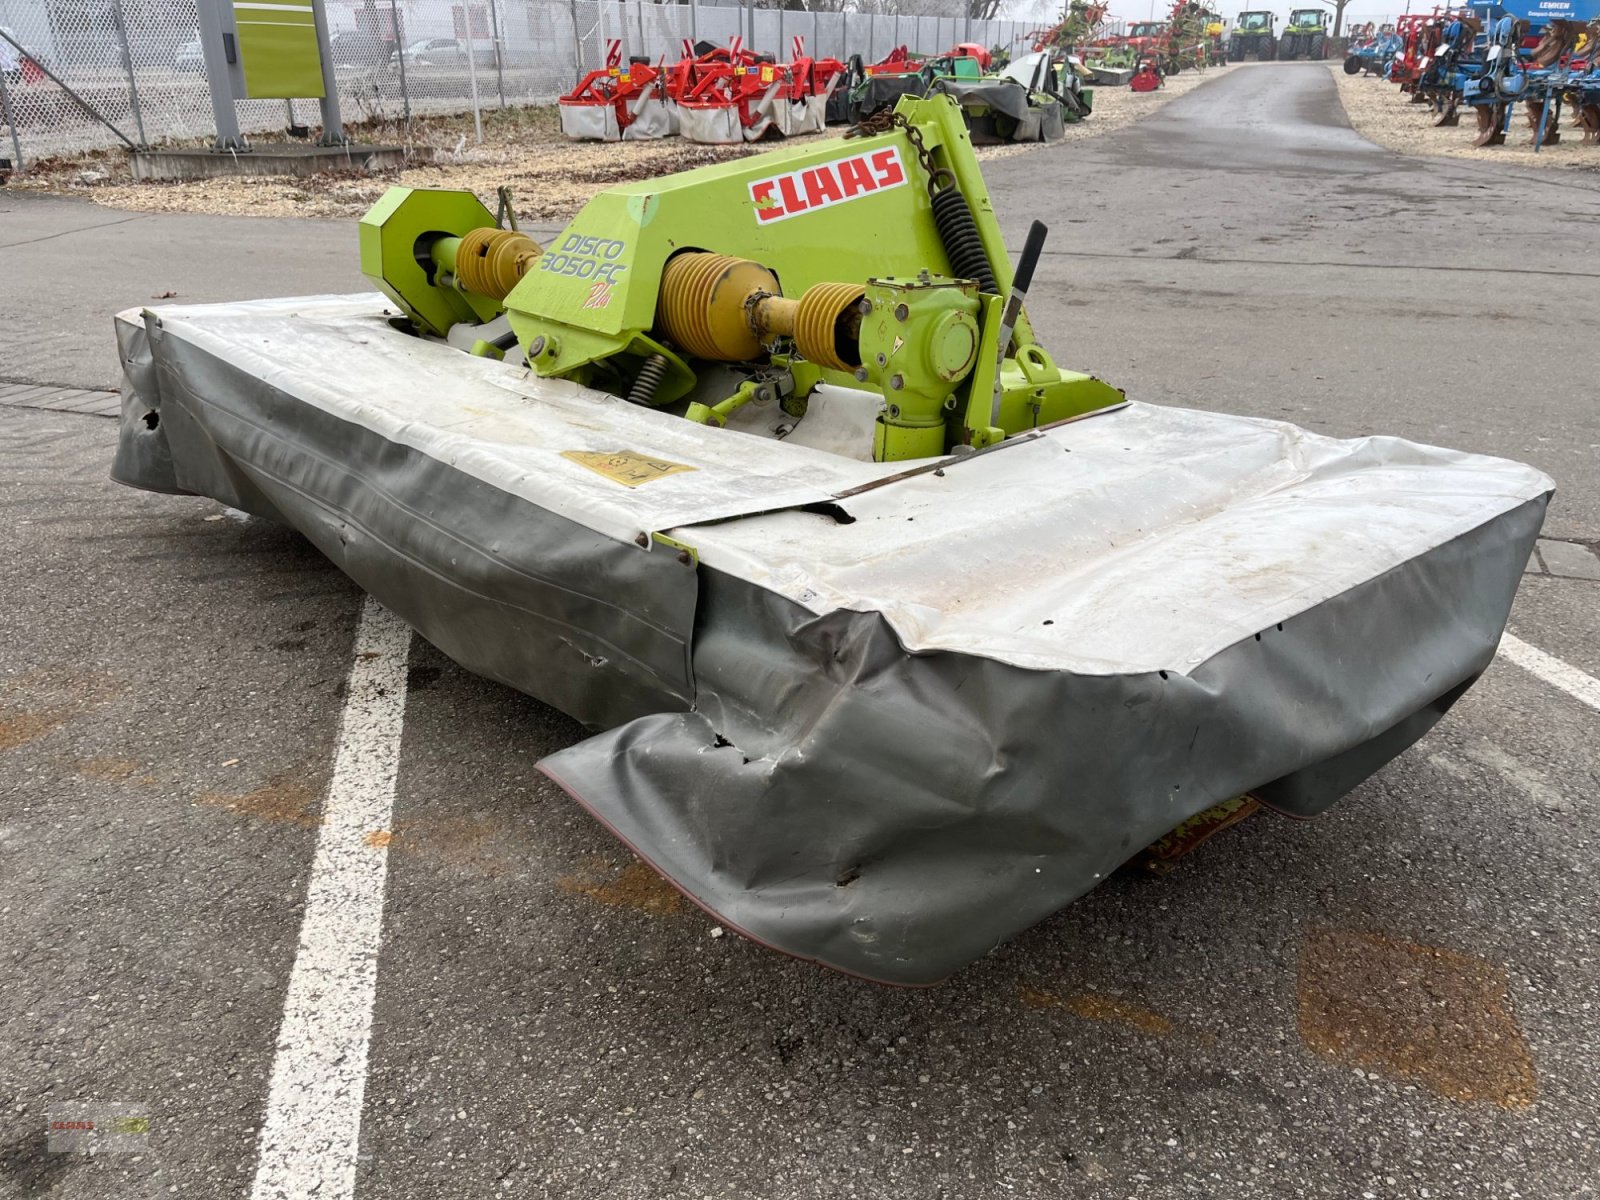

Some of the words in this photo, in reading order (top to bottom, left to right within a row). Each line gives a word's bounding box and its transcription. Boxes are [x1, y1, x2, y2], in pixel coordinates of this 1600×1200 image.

[752, 149, 904, 221] CLAAS
[561, 233, 625, 261] DISCO
[540, 252, 596, 279] 3050
[592, 262, 628, 285] FC
